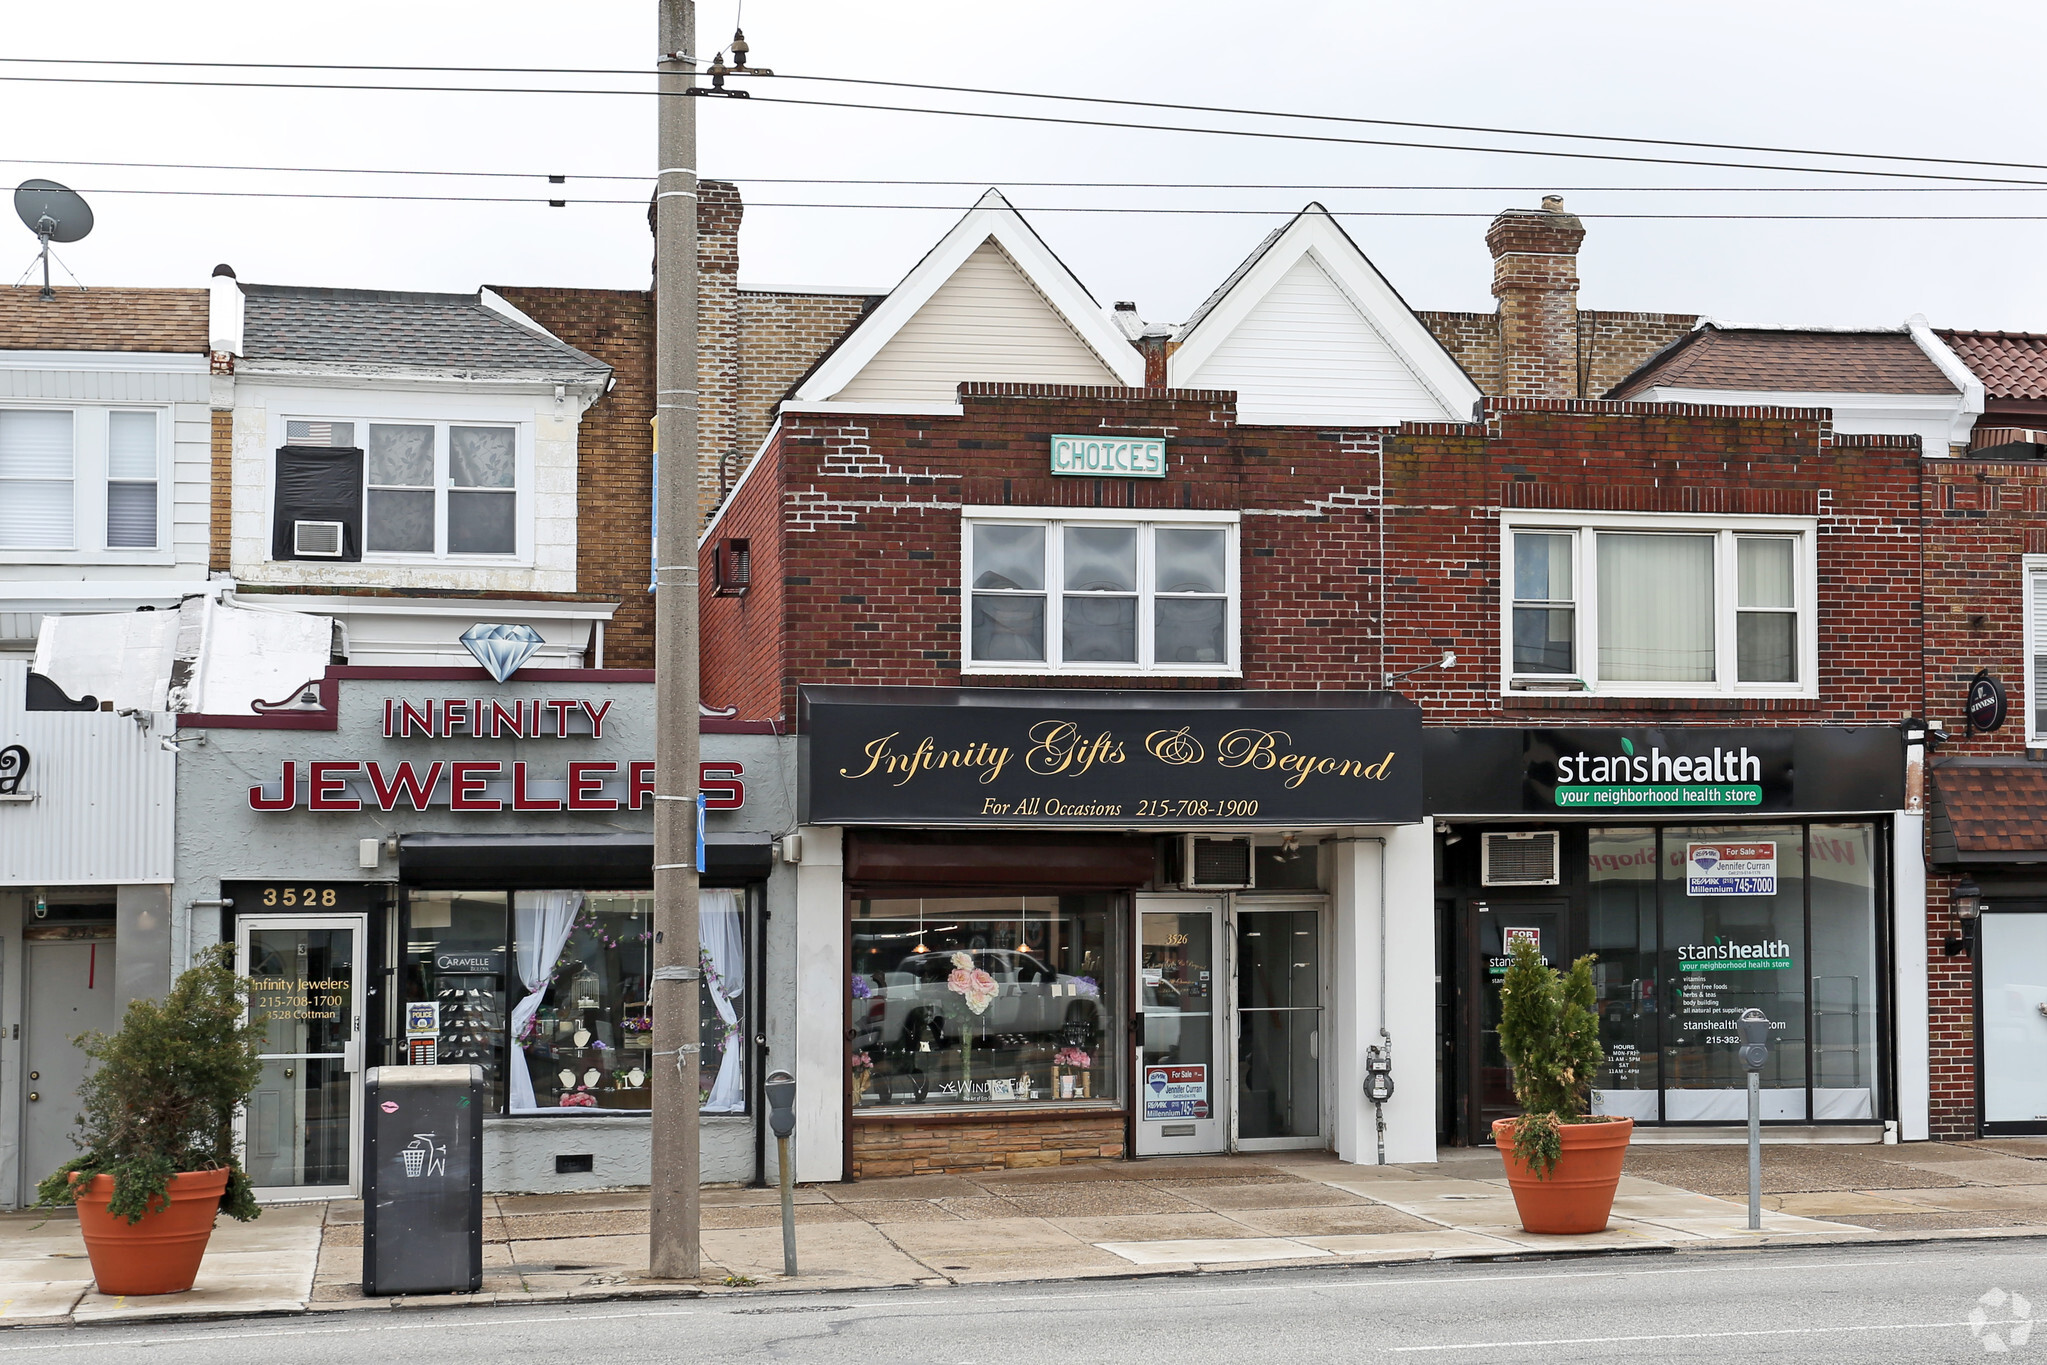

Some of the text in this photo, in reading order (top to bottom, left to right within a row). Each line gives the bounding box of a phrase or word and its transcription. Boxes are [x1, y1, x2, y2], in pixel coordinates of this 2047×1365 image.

[1057, 441, 1159, 471] CHOICES
[382, 698, 615, 740] INFINITY
[840, 720, 1395, 789] Infinity Gifts & Beyond
[1561, 788, 1757, 805] your neighborhood health store
[981, 797, 1259, 817] For All Occasions 215-708-1900
[1717, 861, 1770, 871] Jennifer Curran
[1691, 885, 1734, 893] Millennium
[1734, 877, 1773, 893] 745-7000
[263, 888, 336, 906] 3528
[1166, 933, 1188, 945] 3526
[1512, 930, 1534, 938] FOR
[437, 955, 490, 969] CARAVELLE
[1682, 960, 1790, 972] your neighborhood health store
[296, 977, 349, 993] Jewelers
[260, 995, 342, 1008] 215-708-1700
[1697, 999, 1719, 1007] building
[293, 1010, 336, 1019] Cottman
[1706, 1036, 1741, 1044] 215-332-
[1171, 1070, 1192, 1078] For Sale
[1166, 1084, 1203, 1094] Jennifer Curran
[1147, 1109, 1181, 1117] Millennium
